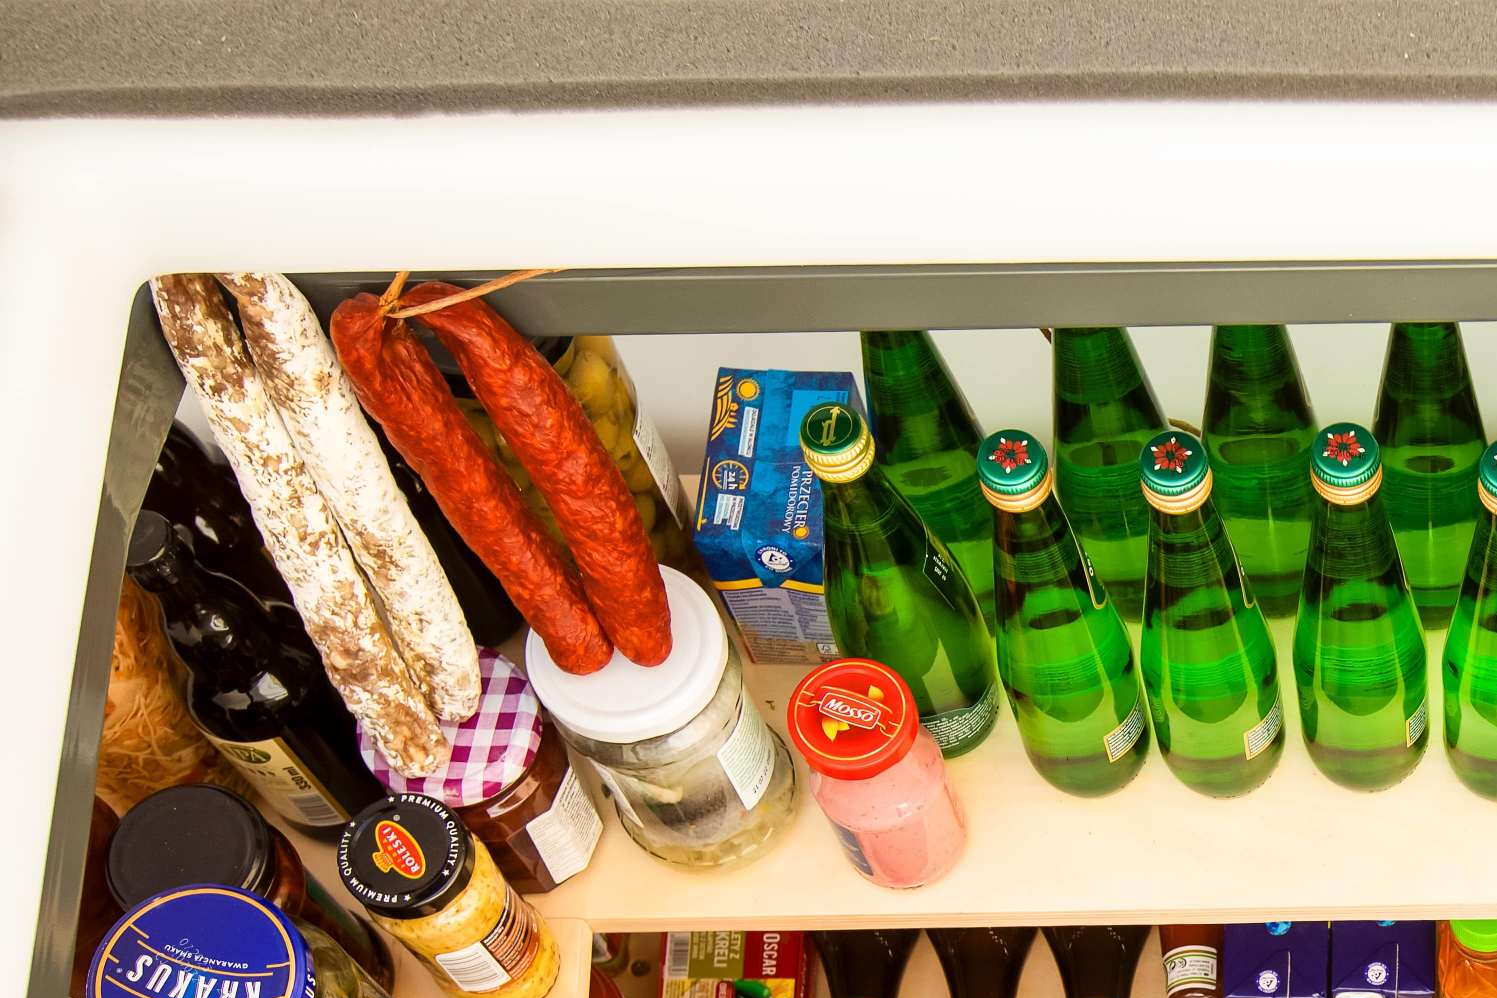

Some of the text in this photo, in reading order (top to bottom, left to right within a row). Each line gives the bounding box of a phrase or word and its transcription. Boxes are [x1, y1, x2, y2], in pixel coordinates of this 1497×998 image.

[782, 465, 800, 534] POMIDOROWY
[799, 470, 814, 529] PRZECIER
[383, 827, 420, 873] ROLESKI
[401, 795, 459, 866] PREMIUM QUALITY
[339, 831, 397, 903] PREMIUM QUALITY
[164, 944, 249, 969] GWARANCJA SMAKU
[714, 931, 728, 967] KRELI
[762, 933, 780, 975] OSCAR
